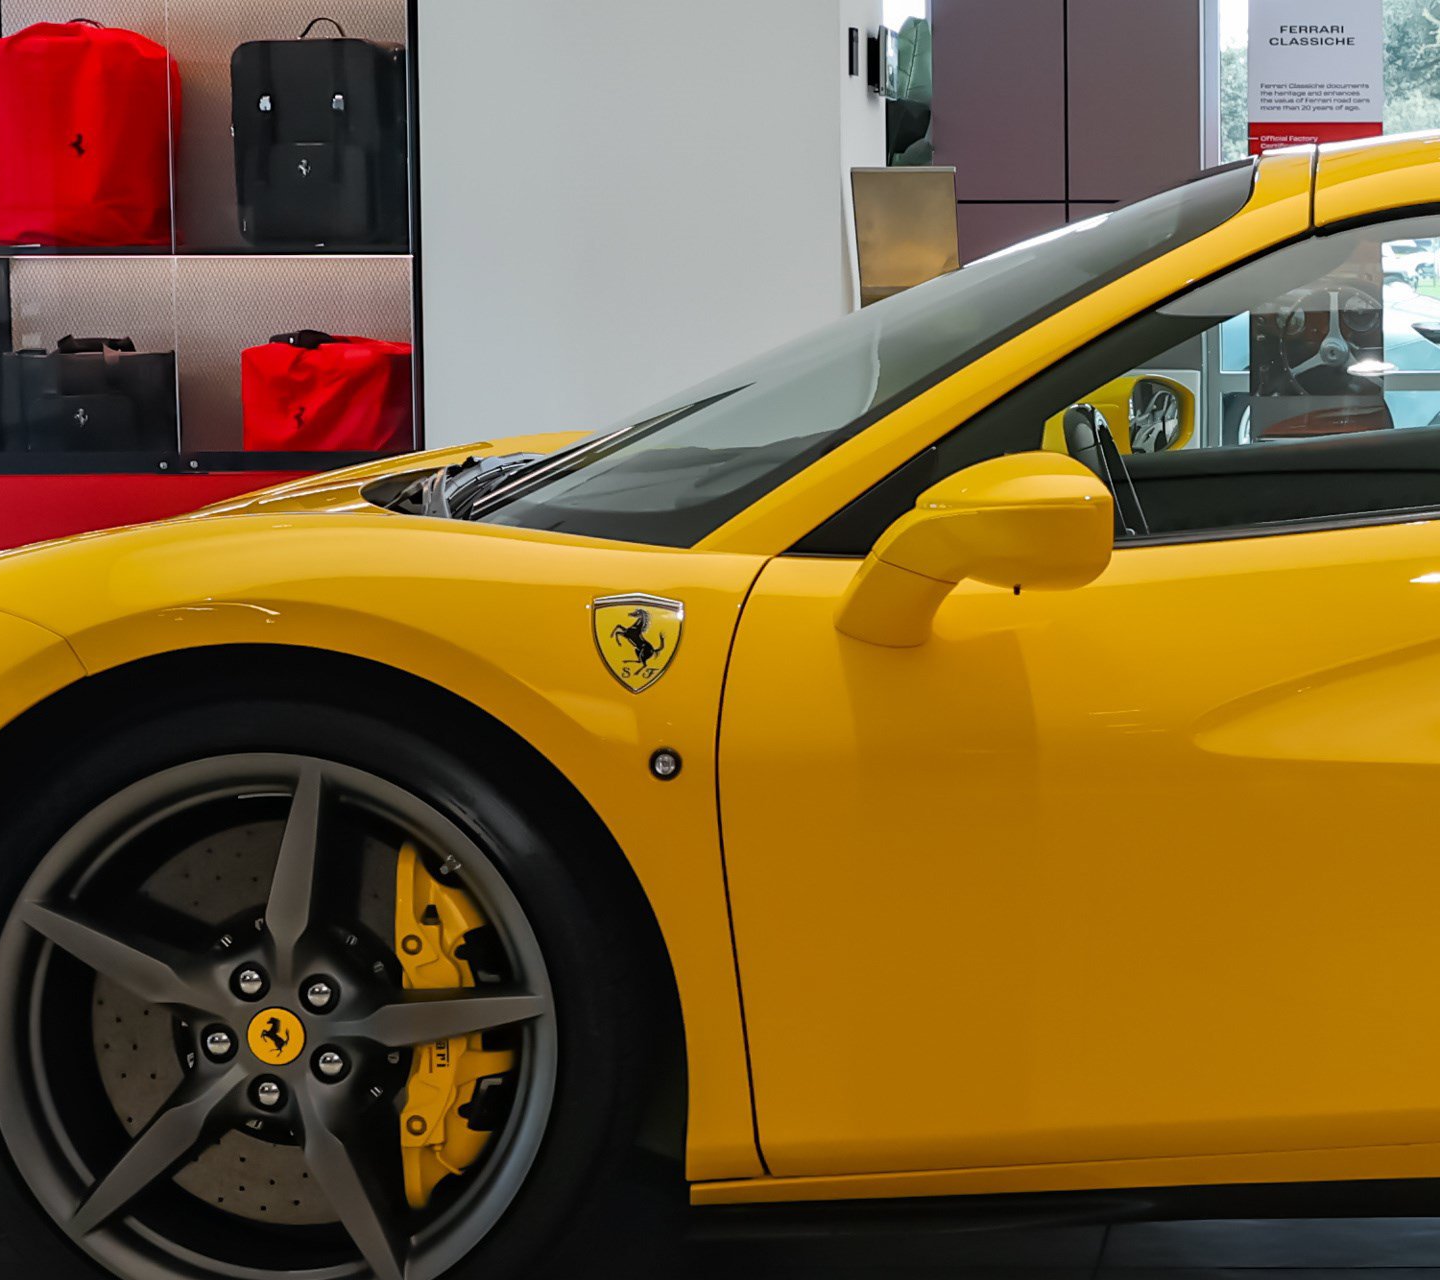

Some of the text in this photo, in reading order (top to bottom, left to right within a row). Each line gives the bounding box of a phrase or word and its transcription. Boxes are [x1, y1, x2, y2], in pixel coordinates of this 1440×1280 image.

[1280, 25, 1344, 34] FERRARI
[1269, 37, 1355, 46] CLASSICHE
[1289, 135, 1319, 143] Factory
